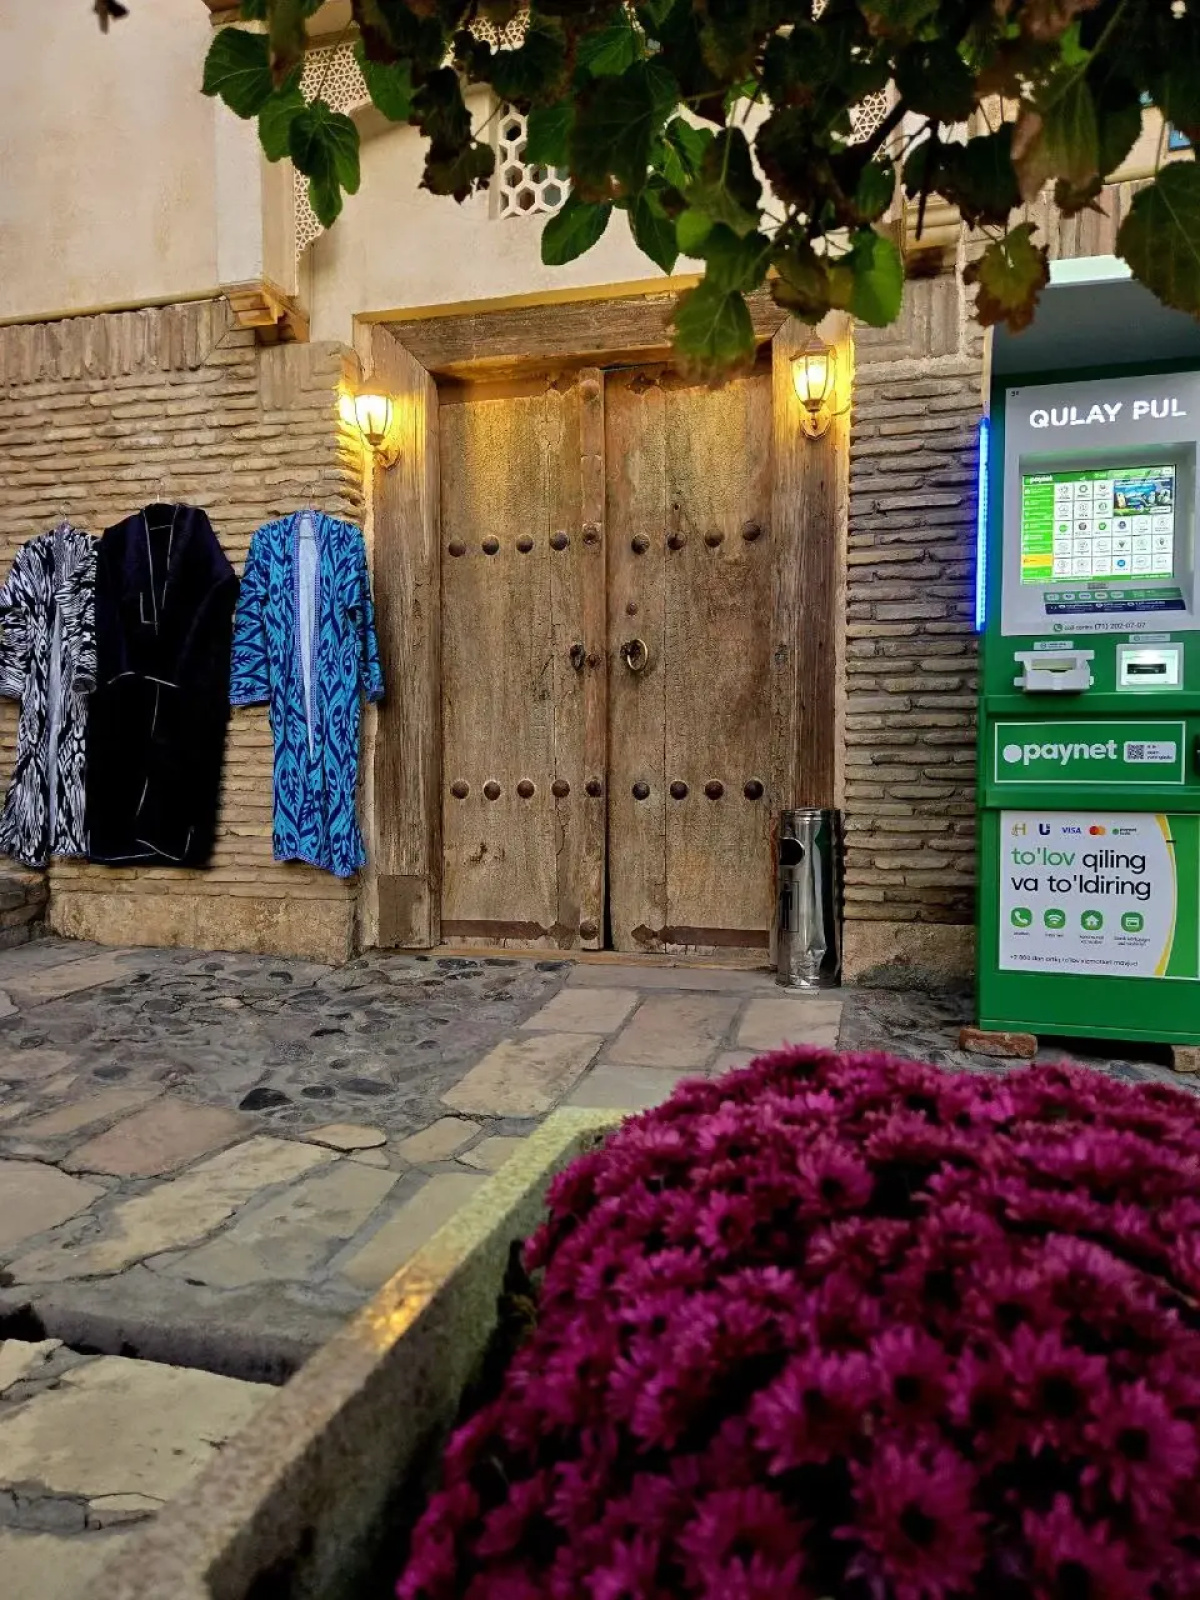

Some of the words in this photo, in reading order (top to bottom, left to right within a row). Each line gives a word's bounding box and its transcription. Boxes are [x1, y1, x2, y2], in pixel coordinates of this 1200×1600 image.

[1029, 402, 1123, 429] QULAY
[1132, 398, 1187, 420] PUL
[1094, 623, 1109, 631] (71)
[1024, 739, 1117, 765] paynet
[1011, 847, 1075, 866] to'lov
[1082, 849, 1146, 875] qiling
[1011, 877, 1038, 891] va
[1047, 874, 1151, 900] to'ldiring
